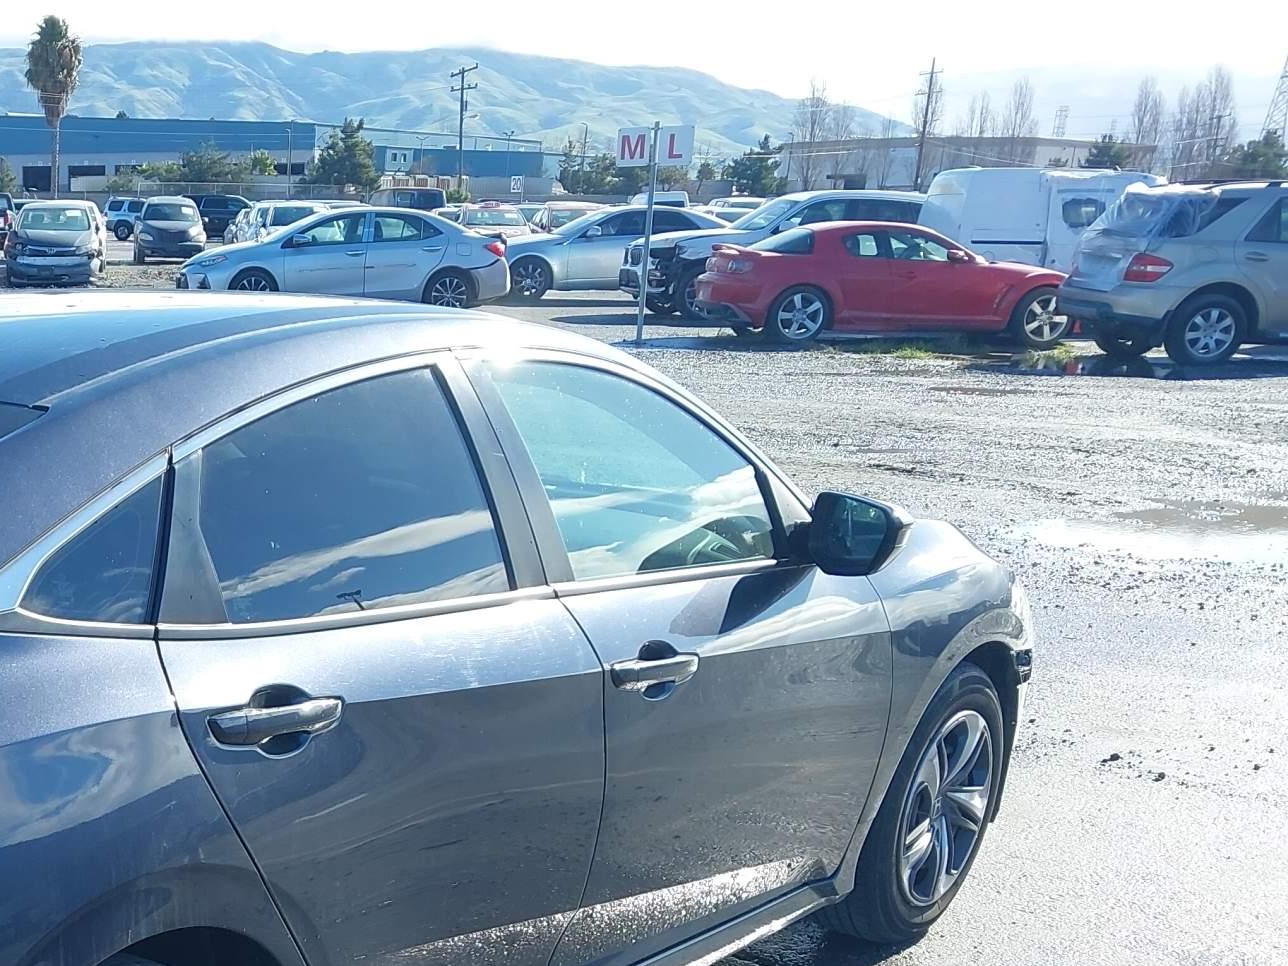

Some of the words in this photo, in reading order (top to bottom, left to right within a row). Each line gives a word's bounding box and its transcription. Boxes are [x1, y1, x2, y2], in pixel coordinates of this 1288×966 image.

[620, 133, 646, 161] M
[667, 133, 683, 159] L
[512, 177, 521, 191] 20
